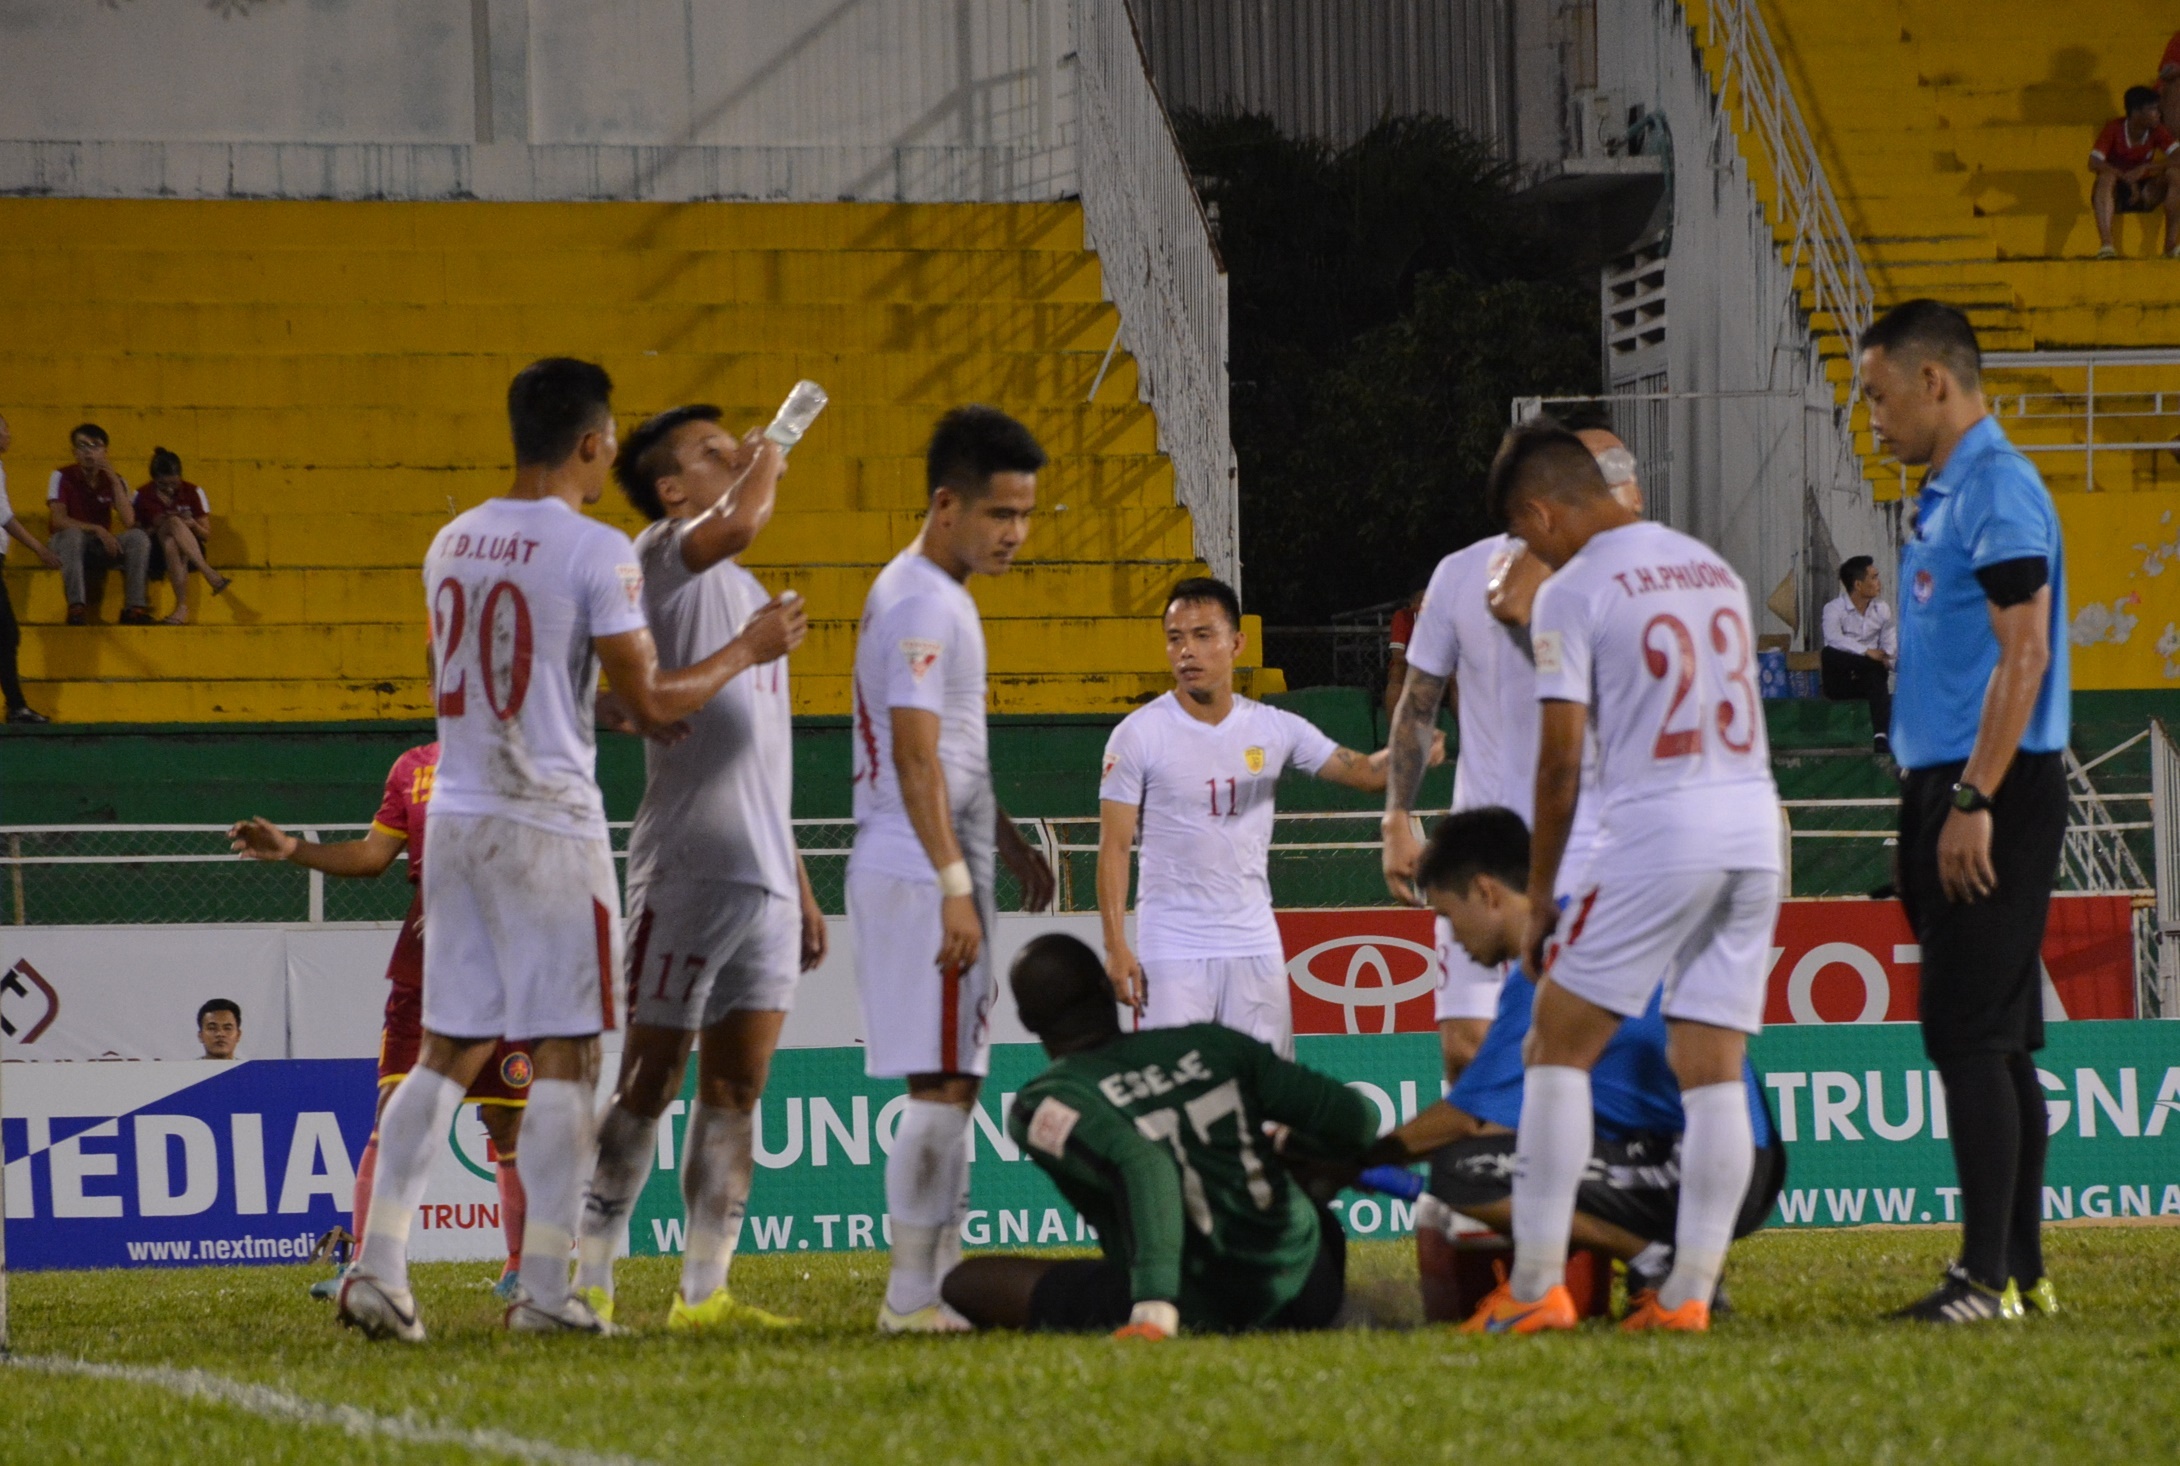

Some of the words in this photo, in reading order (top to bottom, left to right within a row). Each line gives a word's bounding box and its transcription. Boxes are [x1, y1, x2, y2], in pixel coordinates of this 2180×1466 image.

[435, 576, 535, 721] 20
[1642, 607, 1757, 760] 23
[1205, 776, 1239, 817] 11
[650, 950, 709, 1003] 17
[1134, 1078, 1273, 1236] 77
[419, 1203, 500, 1230] TRUN
